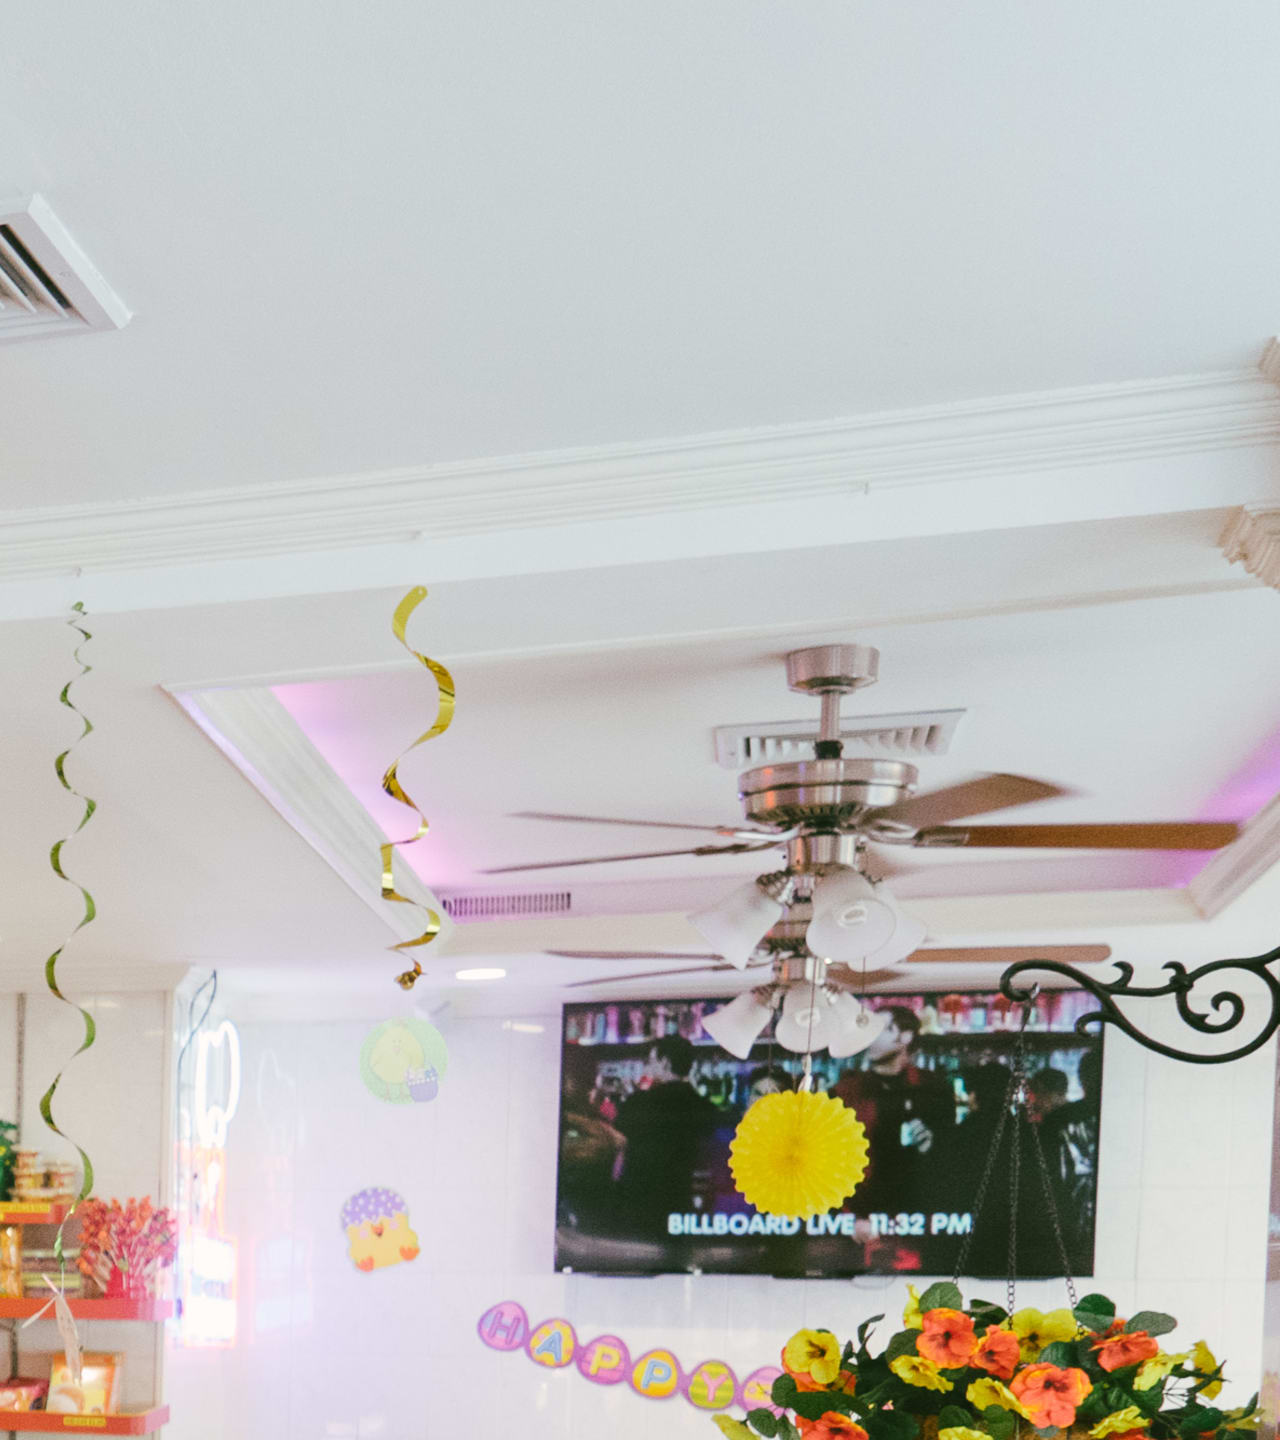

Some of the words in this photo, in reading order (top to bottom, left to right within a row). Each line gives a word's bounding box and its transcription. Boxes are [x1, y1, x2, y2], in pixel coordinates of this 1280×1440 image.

[667, 1212, 803, 1237] BILLBOARD
[806, 1214, 855, 1237] LIVE
[868, 1212, 924, 1236] 11:32
[931, 1212, 972, 1236] PM
[488, 1310, 729, 1402] HAPPY
